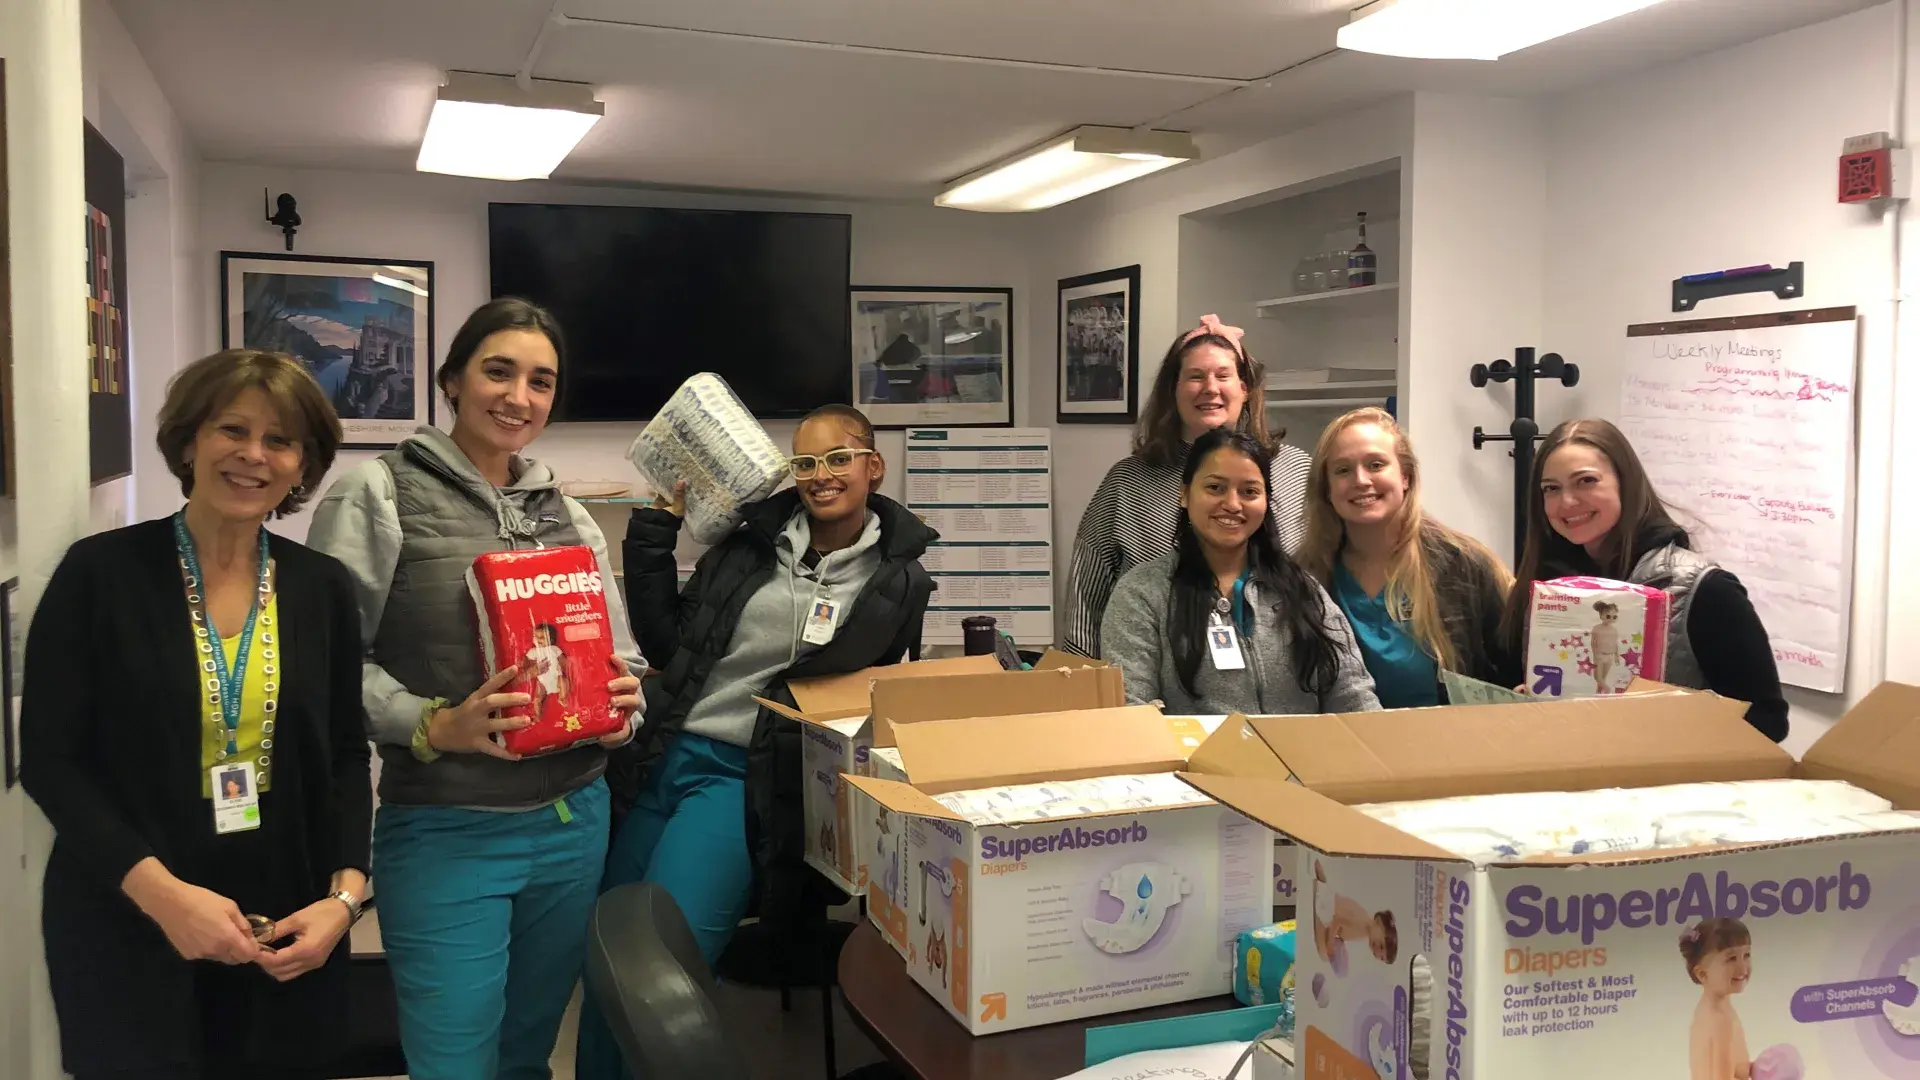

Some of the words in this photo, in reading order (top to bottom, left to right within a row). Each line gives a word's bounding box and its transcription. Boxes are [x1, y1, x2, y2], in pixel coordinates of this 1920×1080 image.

[1653, 340, 1723, 360] Weekly
[1727, 341, 1783, 363] Meetings
[343, 425, 383, 433] HESHIRE
[495, 571, 602, 603] HUGGIES
[564, 602, 591, 613] little
[1537, 603, 1568, 612] pants
[1539, 593, 1581, 604] training
[555, 611, 602, 624] snugglers
[241, 632, 250, 655] Health
[213, 646, 226, 669] Health
[1784, 650, 1824, 668] month
[234, 664, 244, 696] Institute
[231, 697, 239, 718] MGH
[980, 821, 1148, 861] SuperAbsorb
[980, 860, 1028, 877] Diapers
[1435, 869, 1446, 940] Diapers
[1505, 862, 1871, 945] SuperAbsorb
[1504, 946, 1608, 977] Diapers
[1086, 984, 1104, 992] made
[1105, 980, 1130, 990] without
[1131, 974, 1164, 985] elemental
[1111, 986, 1143, 998] parabens
[1503, 984, 1529, 996] Our
[1533, 979, 1583, 994] Softest
[1587, 977, 1597, 988] &
[1601, 974, 1635, 987] Most
[1803, 991, 1825, 1003] with
[1825, 983, 1896, 1001] SuperAbsorb
[1503, 992, 1589, 1010] Comfortable
[1593, 988, 1638, 1002] Diaper
[1825, 998, 1876, 1014] Channels
[1503, 1011, 1529, 1023] with
[1532, 1011, 1548, 1022] up
[1552, 1008, 1564, 1019] to
[1567, 1006, 1580, 1017] 12
[1583, 1003, 1619, 1016] hours
[1502, 1024, 1529, 1037] leak
[1532, 1019, 1594, 1037] protection
